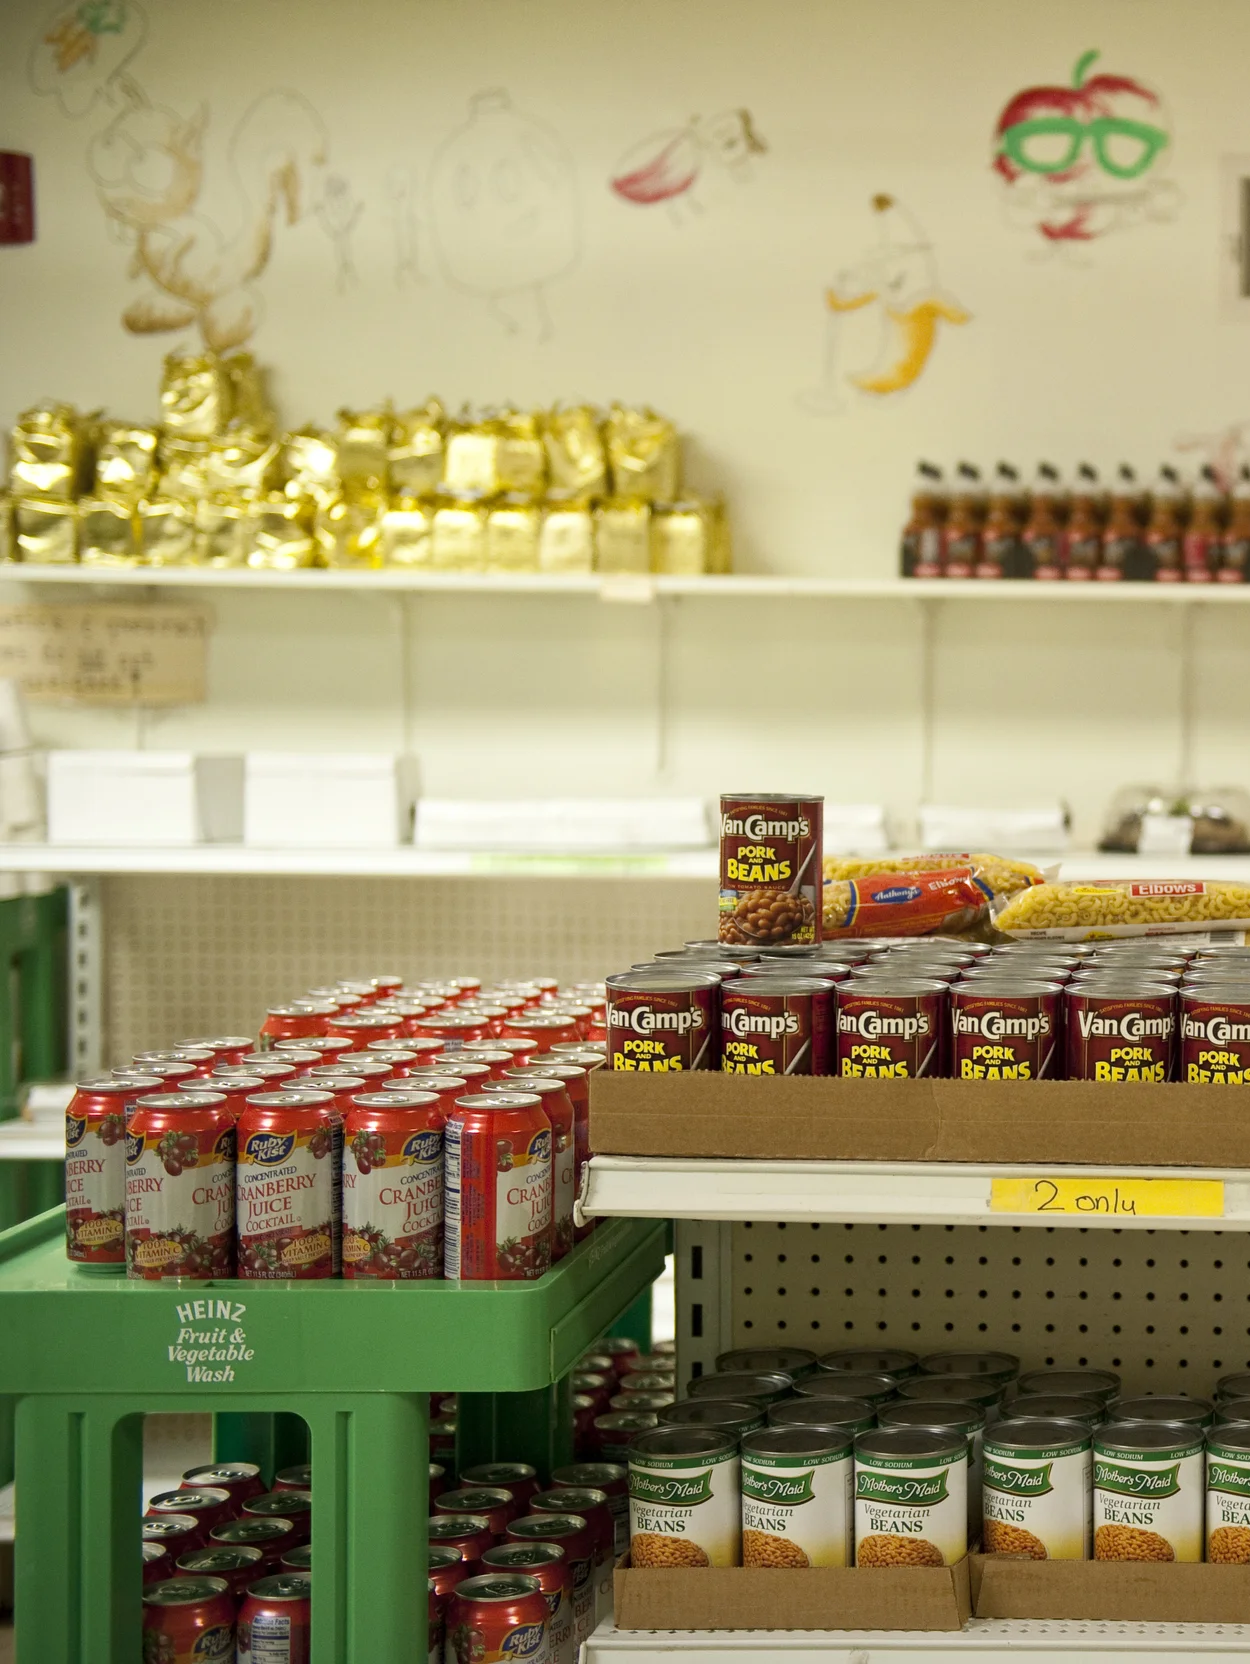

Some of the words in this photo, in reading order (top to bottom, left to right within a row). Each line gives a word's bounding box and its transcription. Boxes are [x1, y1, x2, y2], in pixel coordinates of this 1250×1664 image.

[738, 846, 776, 860] PORK
[727, 858, 791, 883] BEANS
[1139, 883, 1196, 895] Elbows
[624, 1040, 665, 1055] PORK
[726, 1042, 759, 1059] PORK
[851, 1045, 892, 1061] PORK
[973, 1045, 1015, 1061] PORK
[1111, 1047, 1152, 1062] PORK
[614, 1053, 683, 1072] BEANS
[1199, 1051, 1240, 1067] PORK
[842, 1058, 908, 1079] BEANS
[961, 1059, 1031, 1080] BEANS
[1095, 1061, 1164, 1082] BEANS
[252, 1136, 287, 1151] Ruby
[411, 1134, 440, 1151] Ruby
[258, 1146, 286, 1160] Kist
[244, 1166, 297, 1183] CONCENTRATED
[238, 1173, 316, 1201] CRANBERRY
[1035, 1180, 1065, 1211] 2
[1075, 1188, 1136, 1215] only
[249, 1196, 292, 1219] JUICE
[246, 1214, 295, 1233] COCKTAIL
[176, 1300, 246, 1323] HEINZ
[176, 1328, 227, 1343] Fruit
[230, 1328, 246, 1343] &
[168, 1344, 254, 1365] Vegetable
[187, 1366, 235, 1382] Wash
[821, 1453, 845, 1463] SODIUM
[993, 1449, 1015, 1457] SODIUM
[1060, 1446, 1083, 1456] SODIUM
[1117, 1452, 1144, 1460] SODIUM
[1221, 1451, 1234, 1459] LOW
[752, 1458, 776, 1466] SODIUM
[629, 1473, 665, 1494] Mother's
[661, 1481, 703, 1500] Maid
[1003, 1470, 1044, 1488] Maid
[1095, 1465, 1135, 1486] Mother's
[1130, 1473, 1171, 1492] Maid
[763, 1480, 804, 1497] Maid
[858, 1475, 903, 1494] Mother's
[899, 1481, 941, 1500] Maid
[633, 1502, 693, 1519] Vegetarian
[864, 1504, 930, 1518] Vegetarian
[1099, 1494, 1161, 1511] Vegetarian
[985, 1503, 1025, 1522] BEANS
[1104, 1508, 1154, 1525] BEANS
[637, 1517, 686, 1532] BEANS
[745, 1513, 786, 1531] BEANS
[870, 1518, 923, 1533] BEANS
[509, 1625, 542, 1647] Ruby
[517, 1632, 541, 1654] Kist
